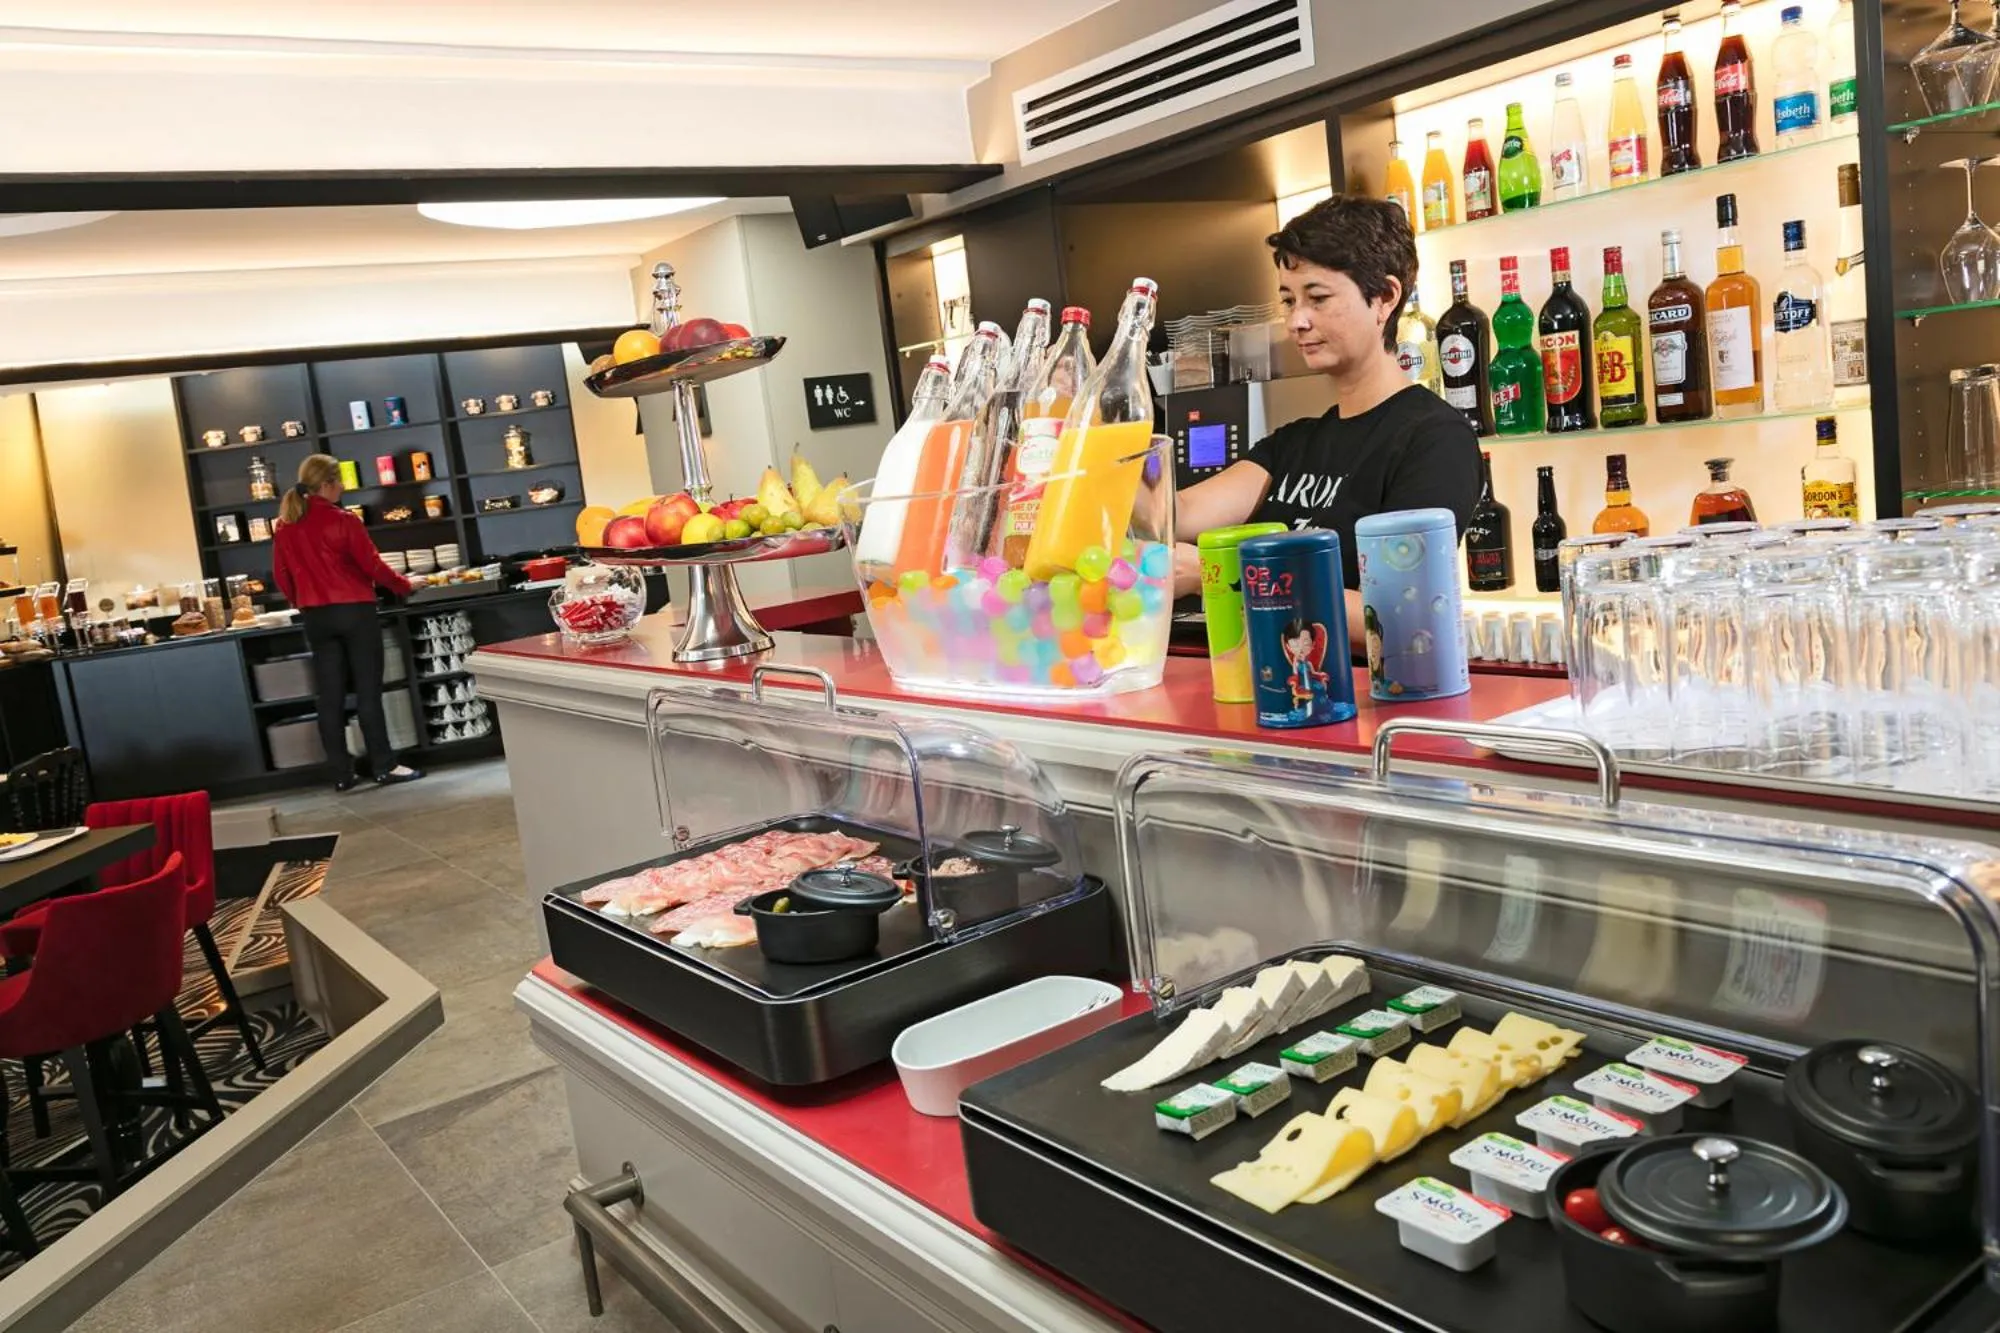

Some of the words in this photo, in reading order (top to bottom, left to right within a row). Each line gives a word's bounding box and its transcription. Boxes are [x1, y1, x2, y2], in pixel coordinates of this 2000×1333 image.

[1831, 89, 1855, 106] beth
[1776, 103, 1811, 120] isbeth
[1650, 307, 1688, 321] ICARD
[1775, 307, 1811, 321] STOFF
[1541, 334, 1576, 348] ICON
[1398, 356, 1423, 367] ARTINI
[1493, 385, 1518, 405] GET
[834, 407, 852, 419] WC
[1466, 527, 1492, 536] TLEY
[1245, 564, 1271, 581] OR
[1247, 573, 1294, 597] TEA?
